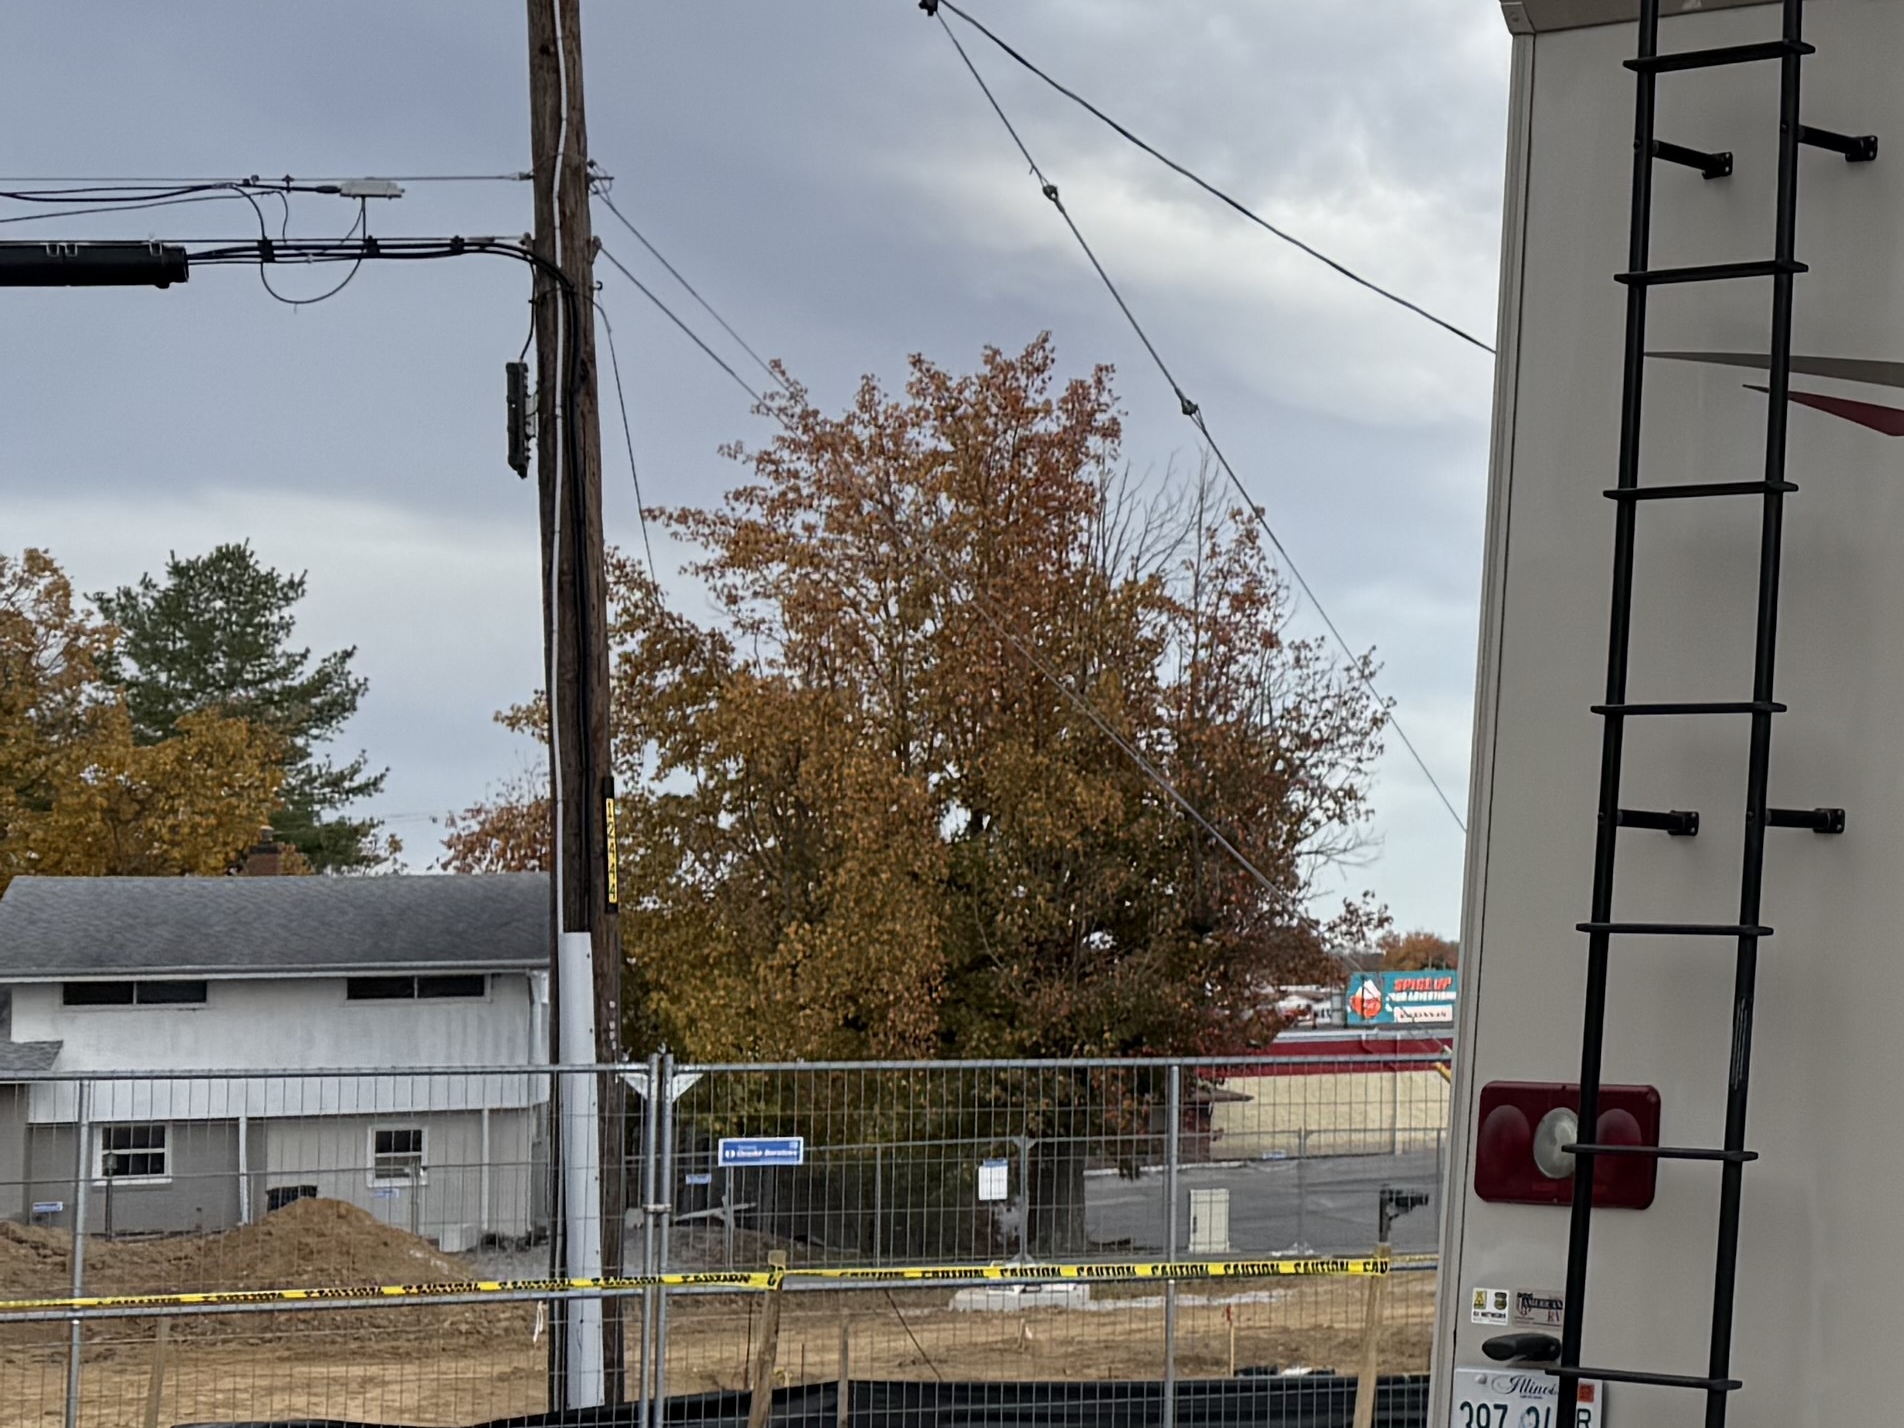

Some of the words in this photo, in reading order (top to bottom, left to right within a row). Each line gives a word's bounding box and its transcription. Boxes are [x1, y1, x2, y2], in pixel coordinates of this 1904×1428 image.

[607, 799, 616, 901] 12444
[1433, 977, 1451, 990] UP
[1224, 1263, 1281, 1276] CAUTION
[1294, 1261, 1350, 1275] CAUTION
[1492, 1375, 1559, 1395] Illinoi
